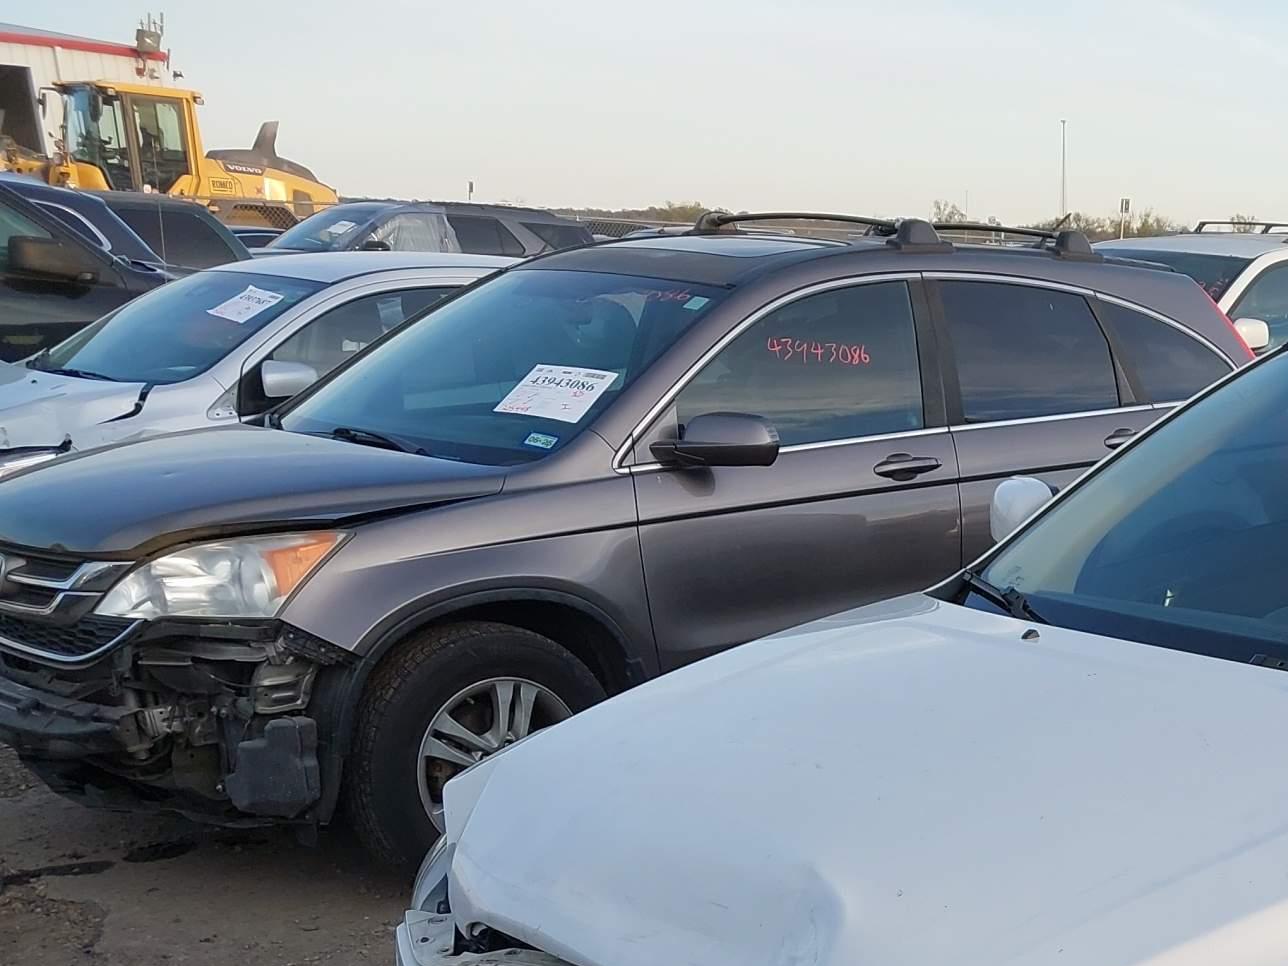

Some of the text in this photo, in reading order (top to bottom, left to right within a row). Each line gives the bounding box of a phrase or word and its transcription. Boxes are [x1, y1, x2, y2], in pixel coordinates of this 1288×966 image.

[226, 164, 262, 174] VOLVO
[767, 336, 871, 365] 43943086
[529, 375, 599, 392] 43943086
